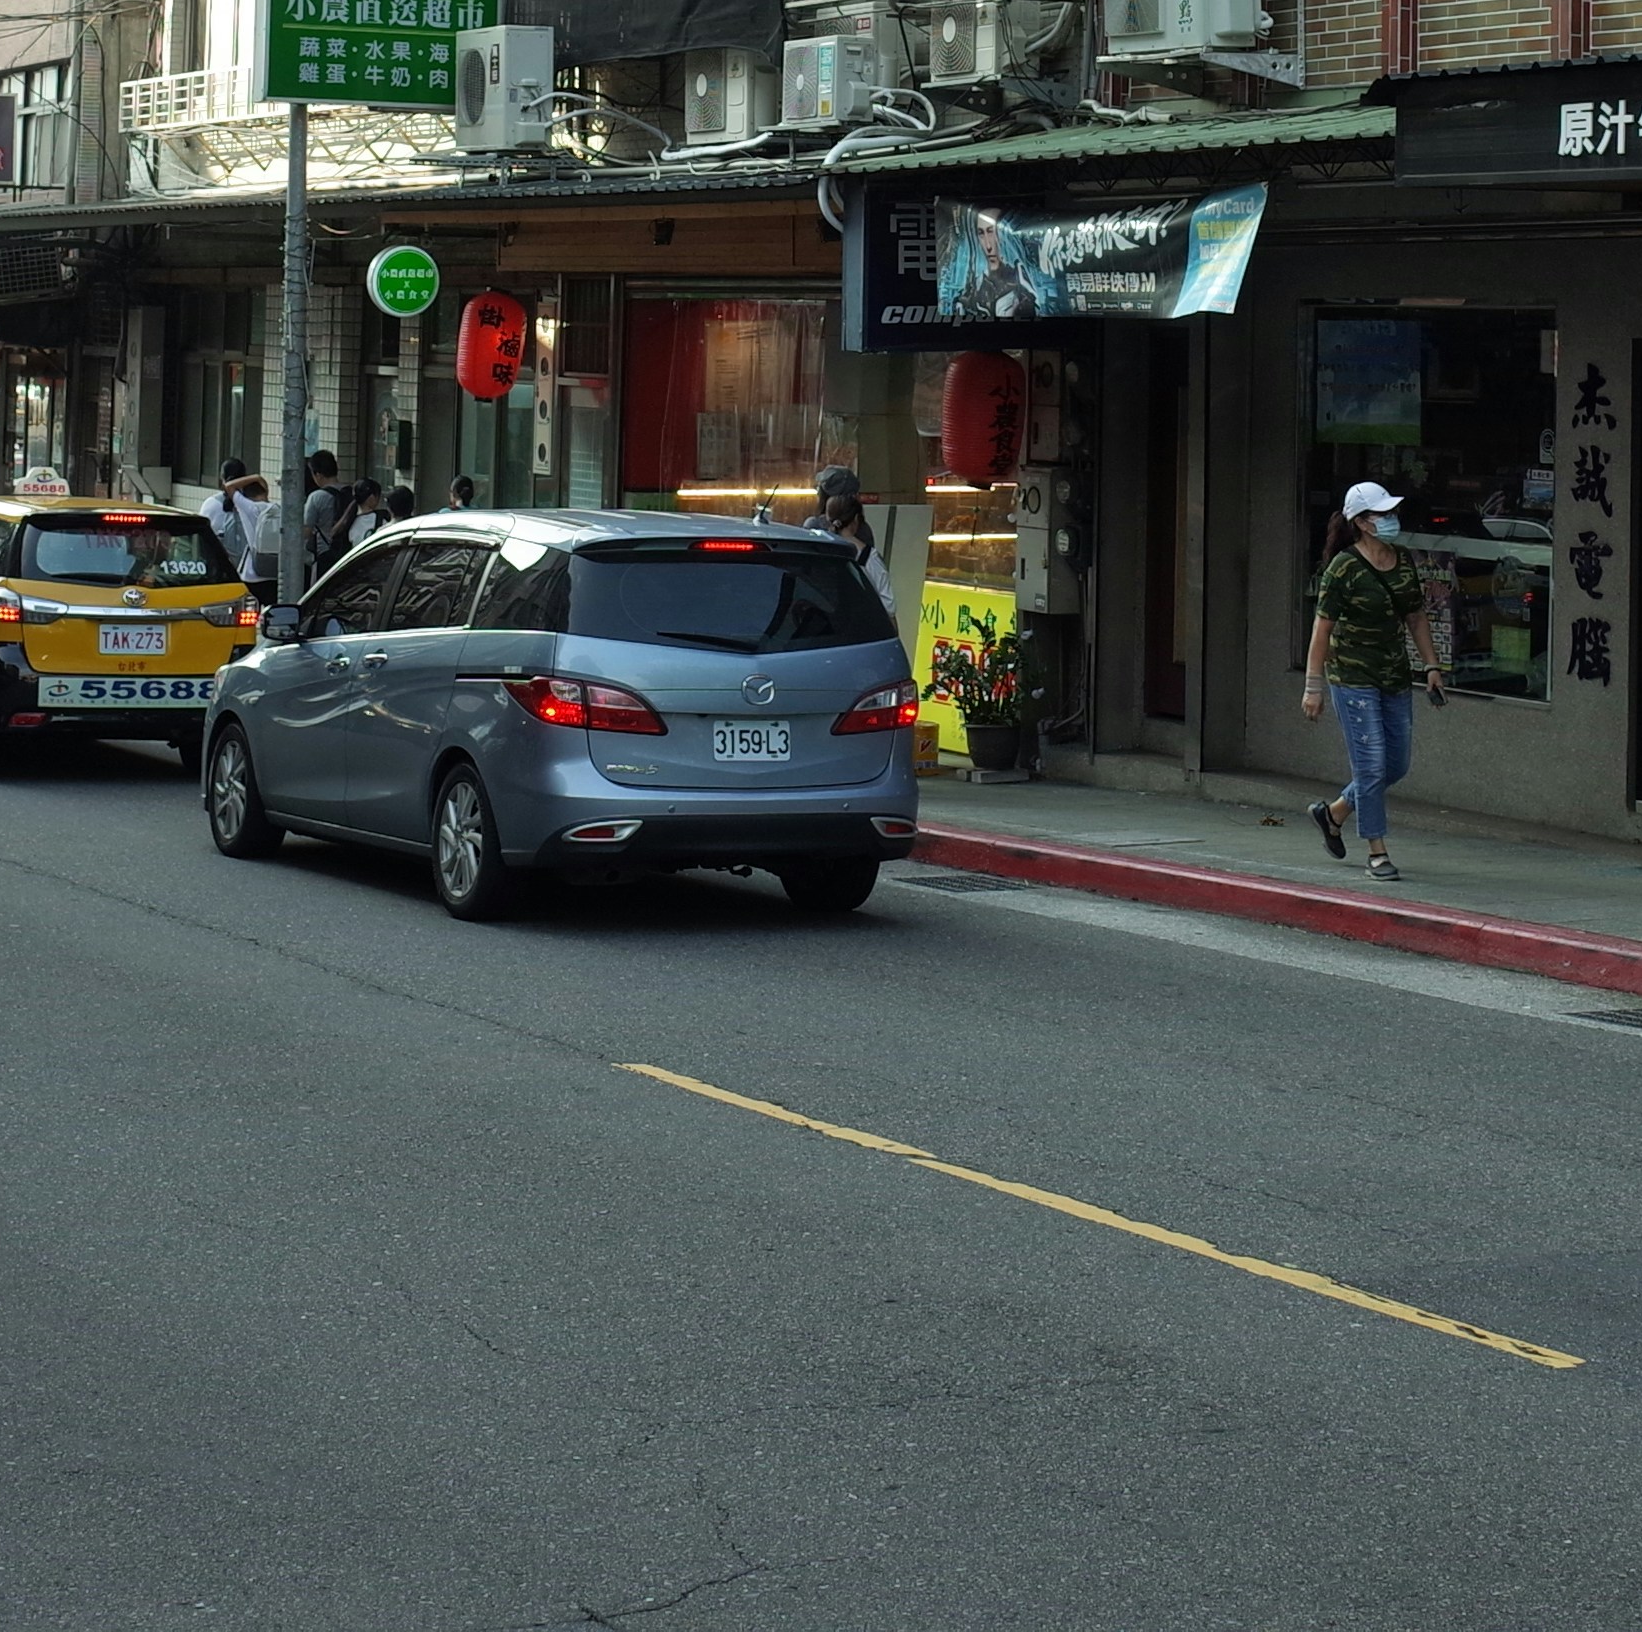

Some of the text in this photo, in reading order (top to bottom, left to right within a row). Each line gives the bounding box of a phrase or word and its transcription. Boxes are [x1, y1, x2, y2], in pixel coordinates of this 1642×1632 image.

[989, 373, 1022, 477] 小農食堂
[23, 483, 66, 493] 55688
[1566, 363, 1619, 687] 杰誠電腦
[160, 561, 206, 575] 13620
[102, 631, 164, 650] TAK-273
